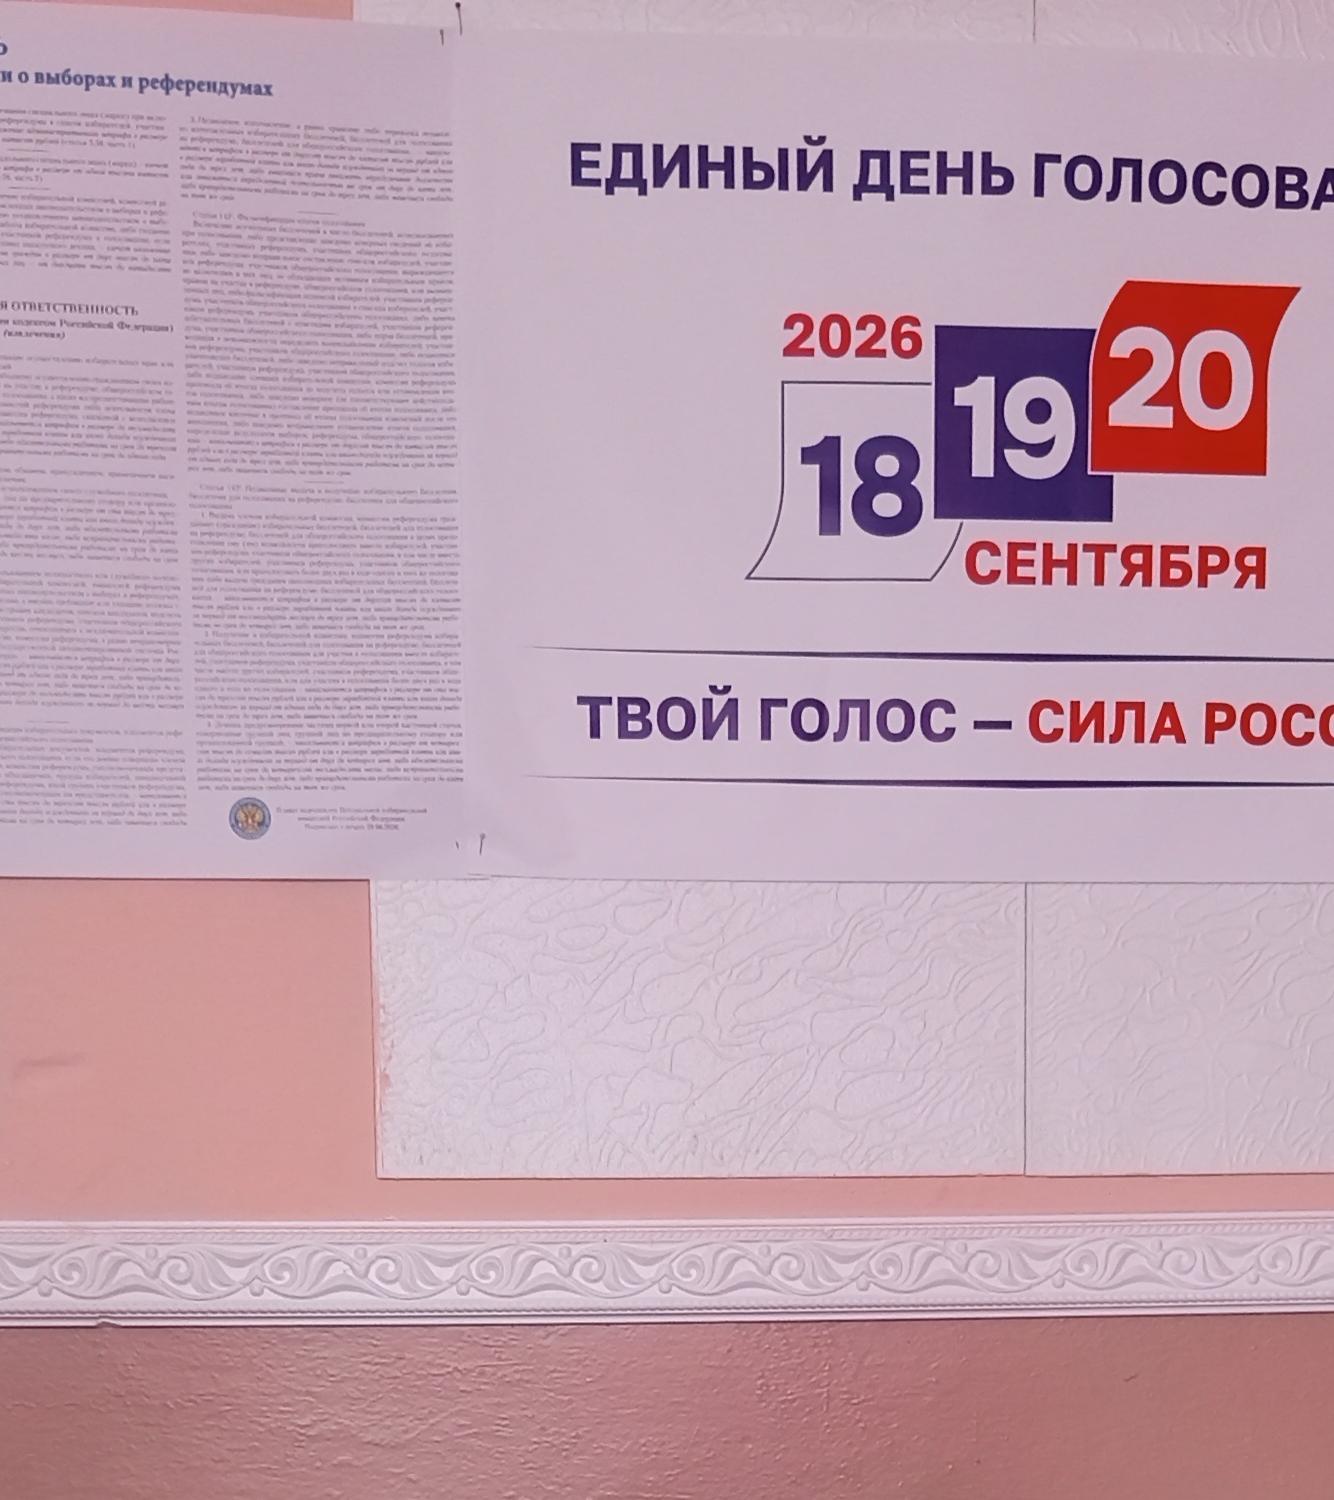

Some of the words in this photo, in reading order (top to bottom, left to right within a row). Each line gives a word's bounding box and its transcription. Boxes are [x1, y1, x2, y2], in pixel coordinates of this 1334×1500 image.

[17, 69, 29, 84] о
[34, 68, 117, 92] выборах
[120, 75, 133, 89] и
[137, 73, 274, 99] референдумах
[569, 134, 834, 196] ЕДИНЫЙ
[853, 149, 1015, 203] ДЕНЬ
[10, 300, 139, 316] ОТВЕТСТВЕННОСТЬ
[782, 312, 924, 361] 2026
[800, 434, 924, 538] 18
[953, 375, 1076, 480] 19
[1108, 326, 1254, 430] 20
[964, 540, 1267, 590] СЕНТЯБРЯ
[577, 684, 739, 742] ТВОЙ
[759, 697, 957, 743] ГОЛОС
[1028, 699, 1187, 746] СИЛА
